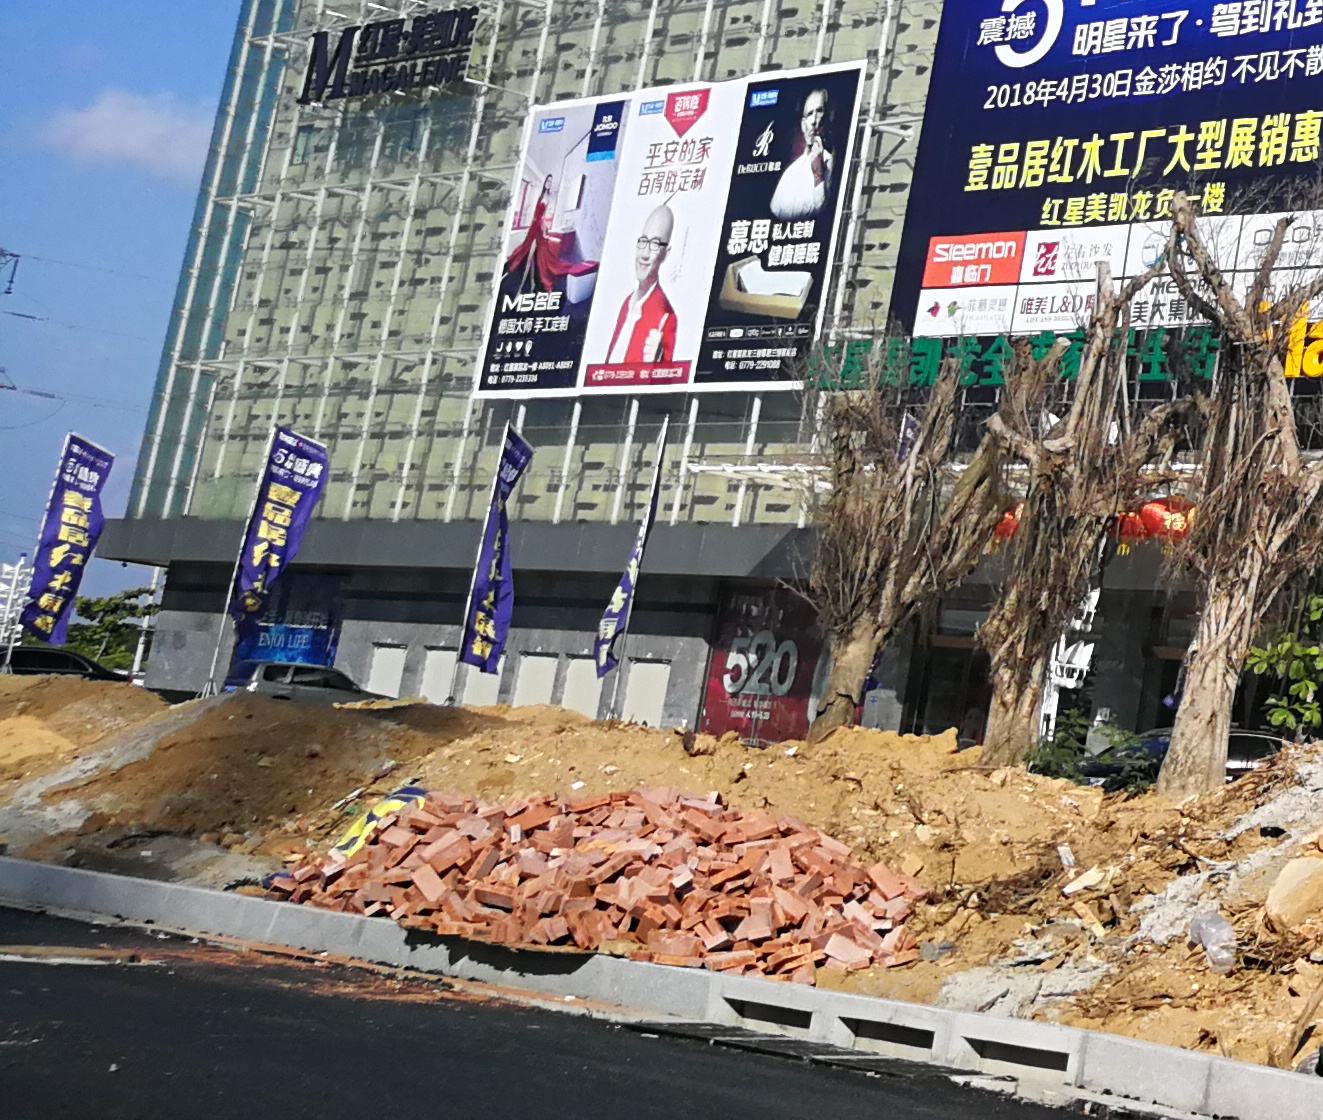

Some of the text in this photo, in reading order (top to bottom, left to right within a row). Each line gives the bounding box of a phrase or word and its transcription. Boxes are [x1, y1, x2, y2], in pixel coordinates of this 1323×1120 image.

[977, 11, 1036, 46] 震撼
[984, 56, 1227, 109] 2018年4月30日金莎相约
[646, 137, 713, 167] 平安的家
[727, 218, 771, 255] 慕思
